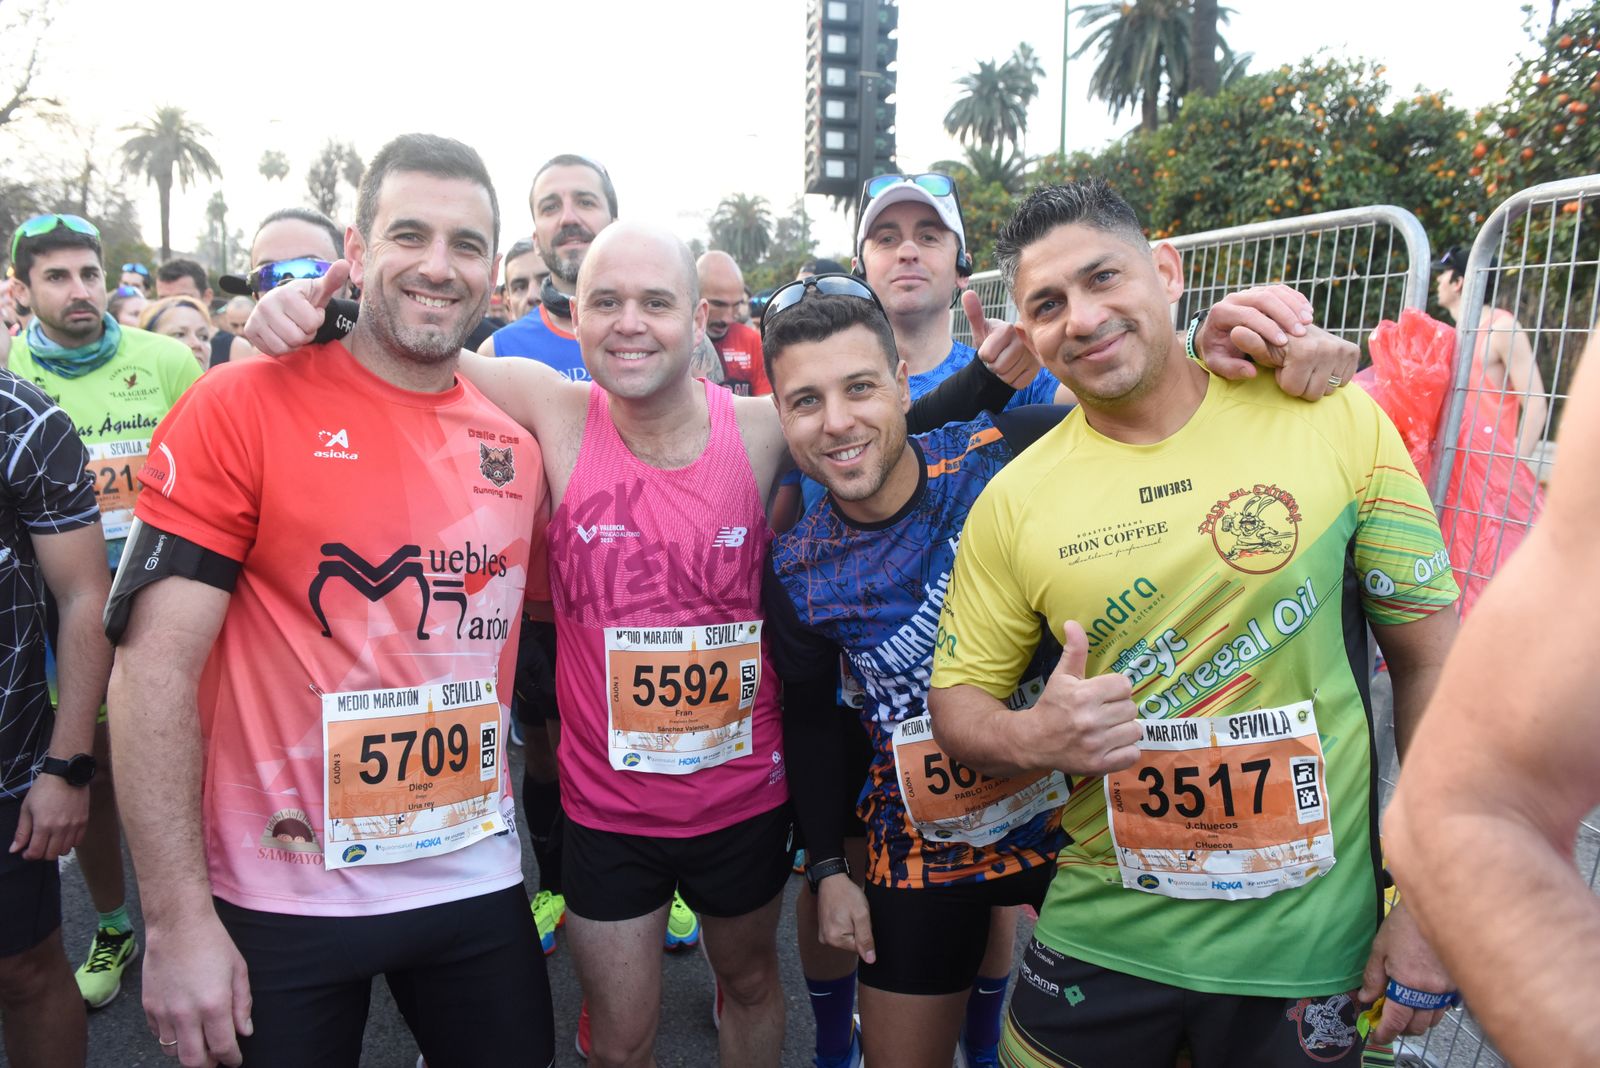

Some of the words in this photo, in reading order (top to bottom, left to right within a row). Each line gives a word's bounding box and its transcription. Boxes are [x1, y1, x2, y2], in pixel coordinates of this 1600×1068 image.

[77, 424, 93, 437] as
[468, 428, 496, 441] Dalle
[499, 434, 520, 445] Gas
[110, 440, 142, 456] SEVILLA
[313, 449, 359, 460] asioka
[473, 485, 504, 498] Running
[505, 490, 523, 501] Team
[1058, 538, 1099, 560] ERON
[1103, 521, 1169, 546] COFFEE
[1086, 576, 1158, 654] andra
[643, 628, 683, 645] MARATÓN
[1138, 617, 1271, 719] Ortegal
[1272, 576, 1319, 636] Oil
[632, 660, 729, 707] 5592
[337, 693, 369, 712] MEDIO
[373, 688, 419, 710] MARATÓN
[442, 681, 482, 706] SEVILLA
[675, 709, 693, 717] Fran
[657, 725, 684, 733] Sánchez
[685, 724, 710, 732] Valencia
[901, 719, 924, 737] MEDIO
[1145, 720, 1199, 742] MARATÓN
[1228, 710, 1292, 740] SEVILLA
[359, 723, 469, 785] 5709
[678, 756, 701, 767] HOKA
[924, 752, 993, 796] 56
[408, 782, 434, 792] Diego
[954, 787, 983, 801] PABLO
[1137, 758, 1272, 819] 3517
[424, 801, 435, 809] rey
[1185, 821, 1238, 831] J.chuecos
[415, 837, 442, 849] HOKA
[1195, 841, 1234, 849] CHuecos
[257, 847, 323, 865] SAMPAYO
[1211, 880, 1243, 891] HOKA
[1395, 984, 1443, 1005] PRIMERA
